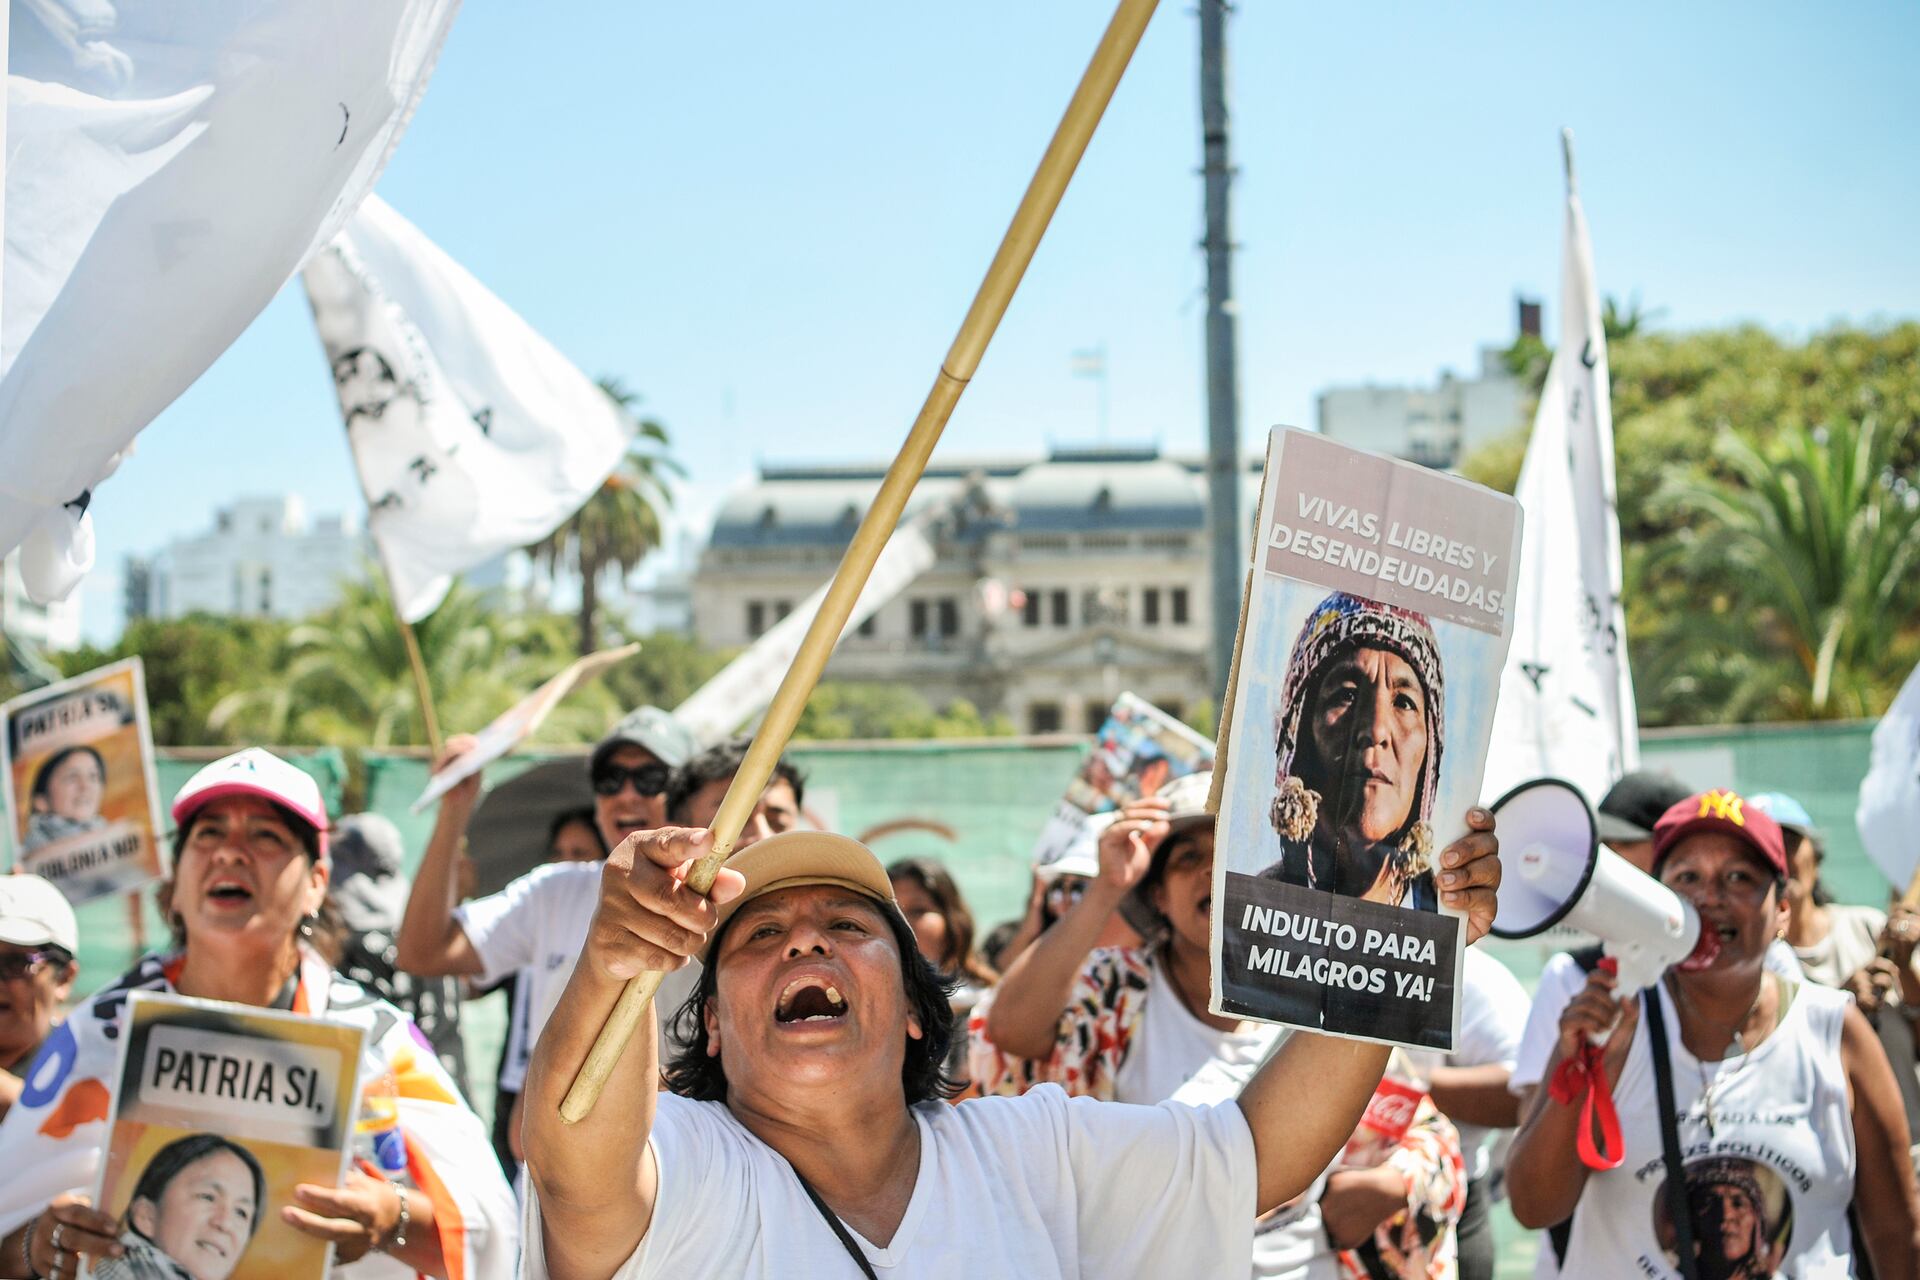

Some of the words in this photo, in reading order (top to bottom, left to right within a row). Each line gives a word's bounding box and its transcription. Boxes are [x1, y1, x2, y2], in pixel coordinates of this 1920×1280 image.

[1298, 492, 1381, 545] VIVAS,
[1387, 521, 1476, 570] LIBRES
[1481, 552, 1498, 576] Y
[1241, 904, 1357, 950] INDULTO
[1362, 929, 1436, 965] PARA
[1247, 945, 1385, 994] MILAGROS
[1394, 971, 1435, 1002] YA!
[153, 1047, 274, 1104] PATRIA
[283, 1065, 324, 1114] SI,
